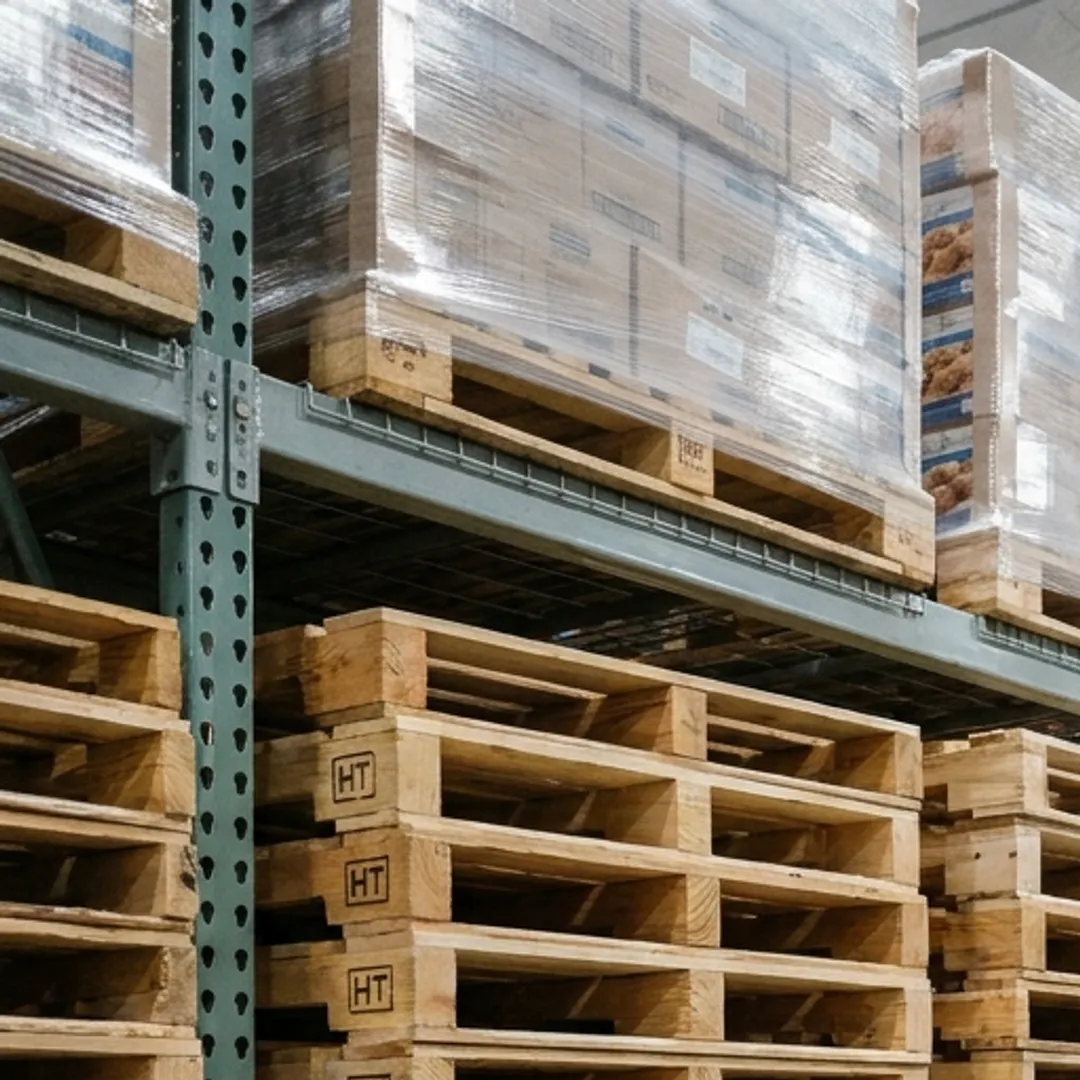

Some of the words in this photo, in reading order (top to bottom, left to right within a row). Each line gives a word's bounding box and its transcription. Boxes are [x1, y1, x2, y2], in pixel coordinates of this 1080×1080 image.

[339, 762, 370, 793] HT
[351, 866, 385, 897] HT
[354, 974, 388, 1005] HT
